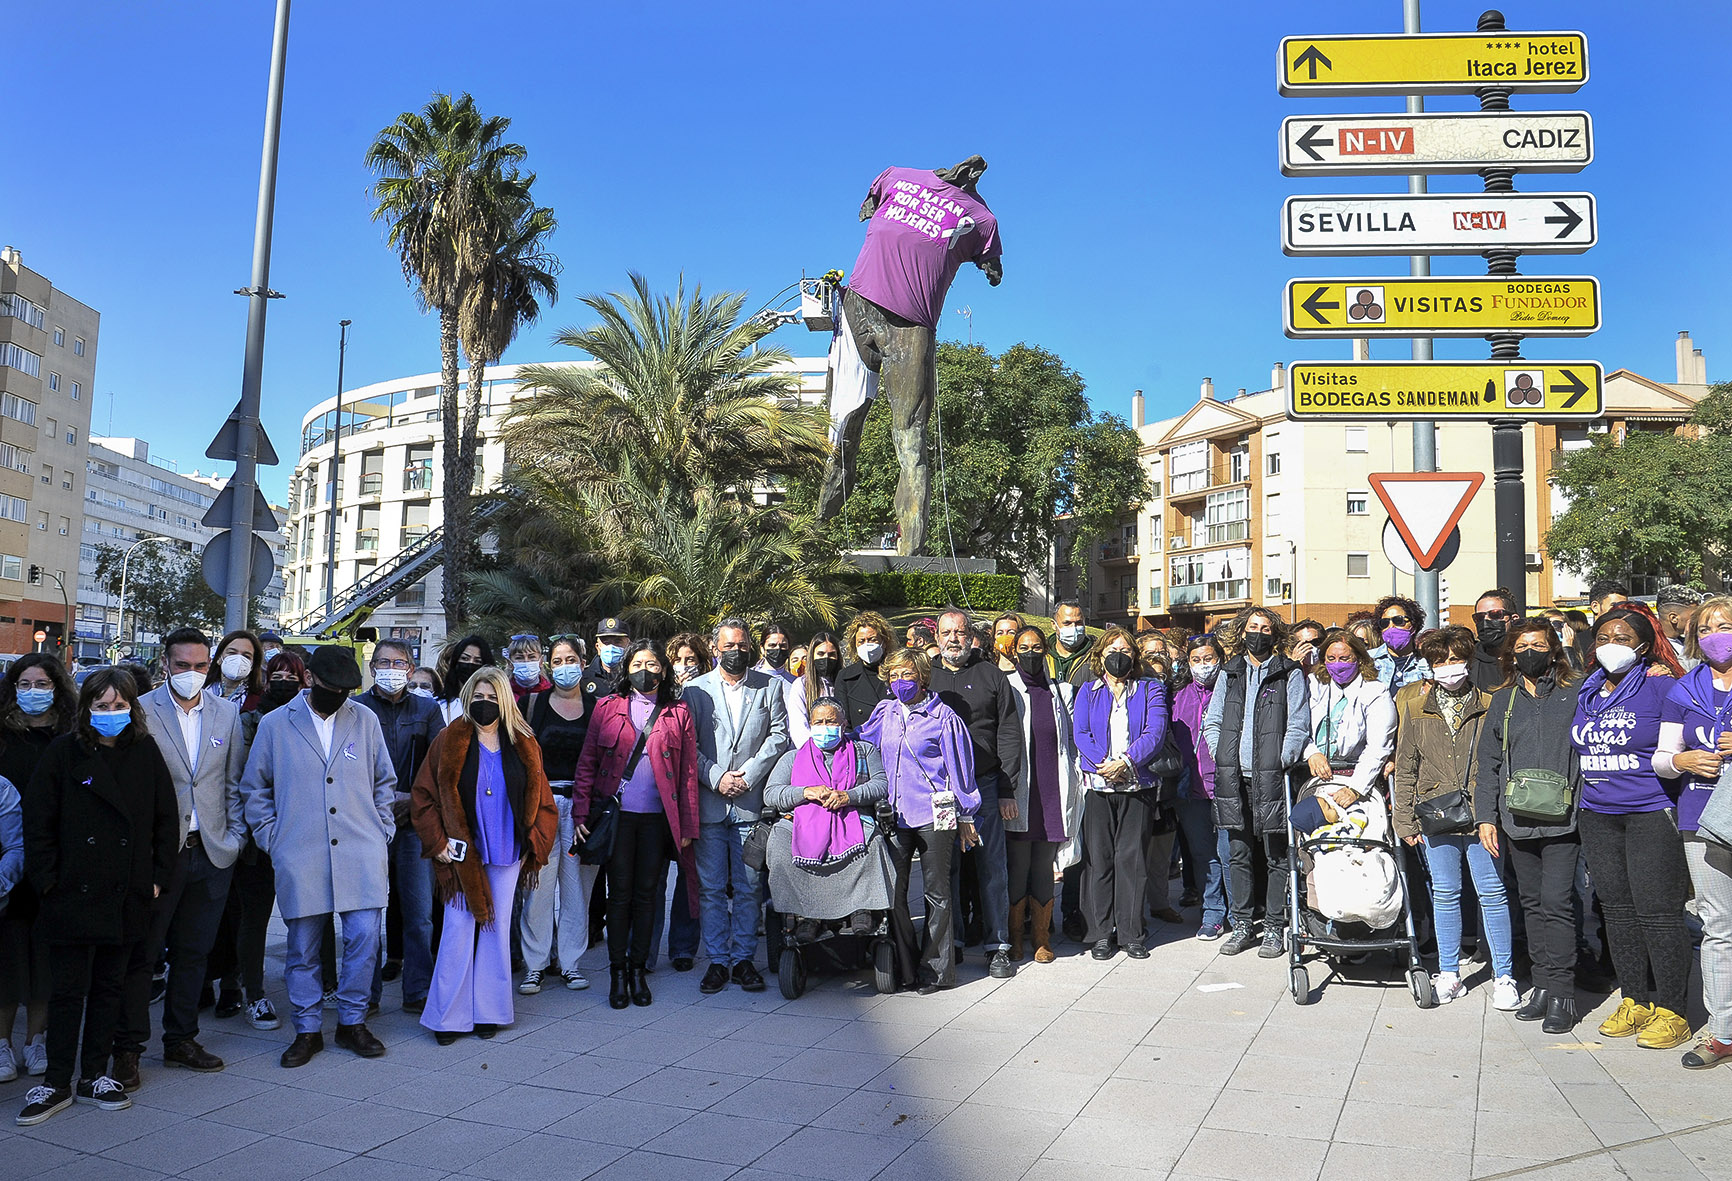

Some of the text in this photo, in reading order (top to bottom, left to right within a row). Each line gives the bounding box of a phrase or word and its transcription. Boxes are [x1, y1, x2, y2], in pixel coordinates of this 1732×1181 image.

[1527, 41, 1575, 56] hotel
[1466, 57, 1577, 77] Itaca Jerez
[1345, 130, 1407, 152] N-IV
[1502, 128, 1581, 149] CADIZ
[893, 181, 965, 217] NOS MATAN
[919, 202, 946, 223] SER
[1298, 211, 1416, 233] SEVILLA
[1454, 211, 1504, 231] N-IV
[1507, 283, 1571, 294] BODEGAS
[1393, 296, 1483, 314] VISITAS
[1491, 295, 1588, 309] FUNDADOR
[1510, 310, 1535, 322] Pedro
[1300, 372, 1358, 386] Visitas
[1300, 390, 1480, 407] BODEGAS SANDEMAN
[1572, 721, 1632, 745] Vivas
[1588, 744, 1611, 756] nos
